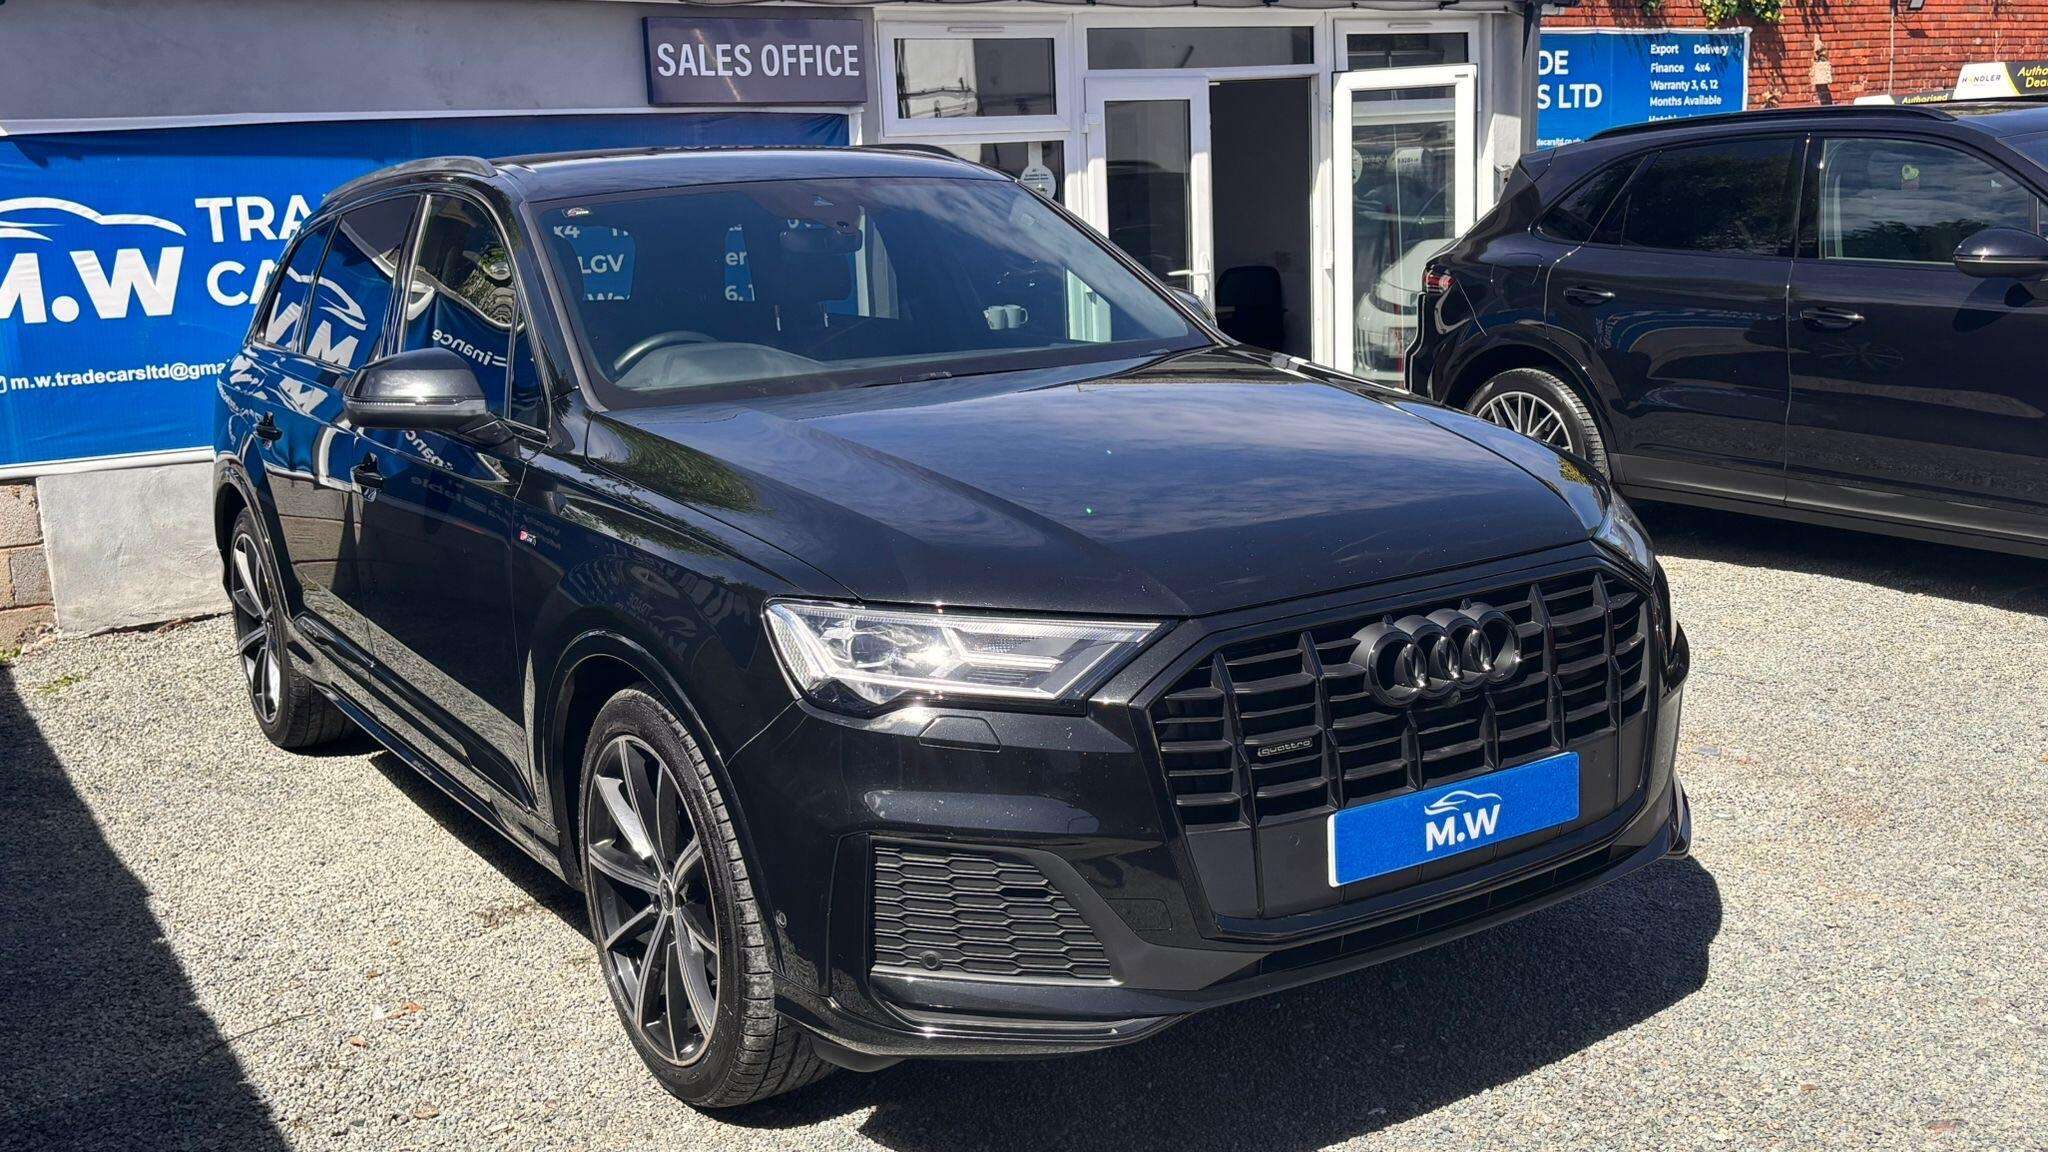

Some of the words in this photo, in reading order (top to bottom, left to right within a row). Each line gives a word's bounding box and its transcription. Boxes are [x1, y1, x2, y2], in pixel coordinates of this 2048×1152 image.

[1650, 44, 1679, 56] Export
[1693, 44, 1729, 56] Delivery
[656, 43, 752, 77] SALES
[761, 44, 860, 77] OFFICE
[1650, 62, 1685, 73] Finance
[1694, 62, 1711, 73] 4x4
[1649, 80, 1690, 92] Warranty
[1710, 79, 1719, 90] 12
[2025, 76, 2048, 88] Dea
[1558, 83, 1603, 109] LTD
[1649, 96, 1682, 107] Months
[1684, 95, 1722, 106] Available
[194, 194, 314, 244] TRA
[577, 254, 625, 274] LGV
[9, 360, 229, 390] m.w.tradecarsltd@gma
[1260, 740, 1311, 756] quattro
[1425, 803, 1500, 852] M.W
